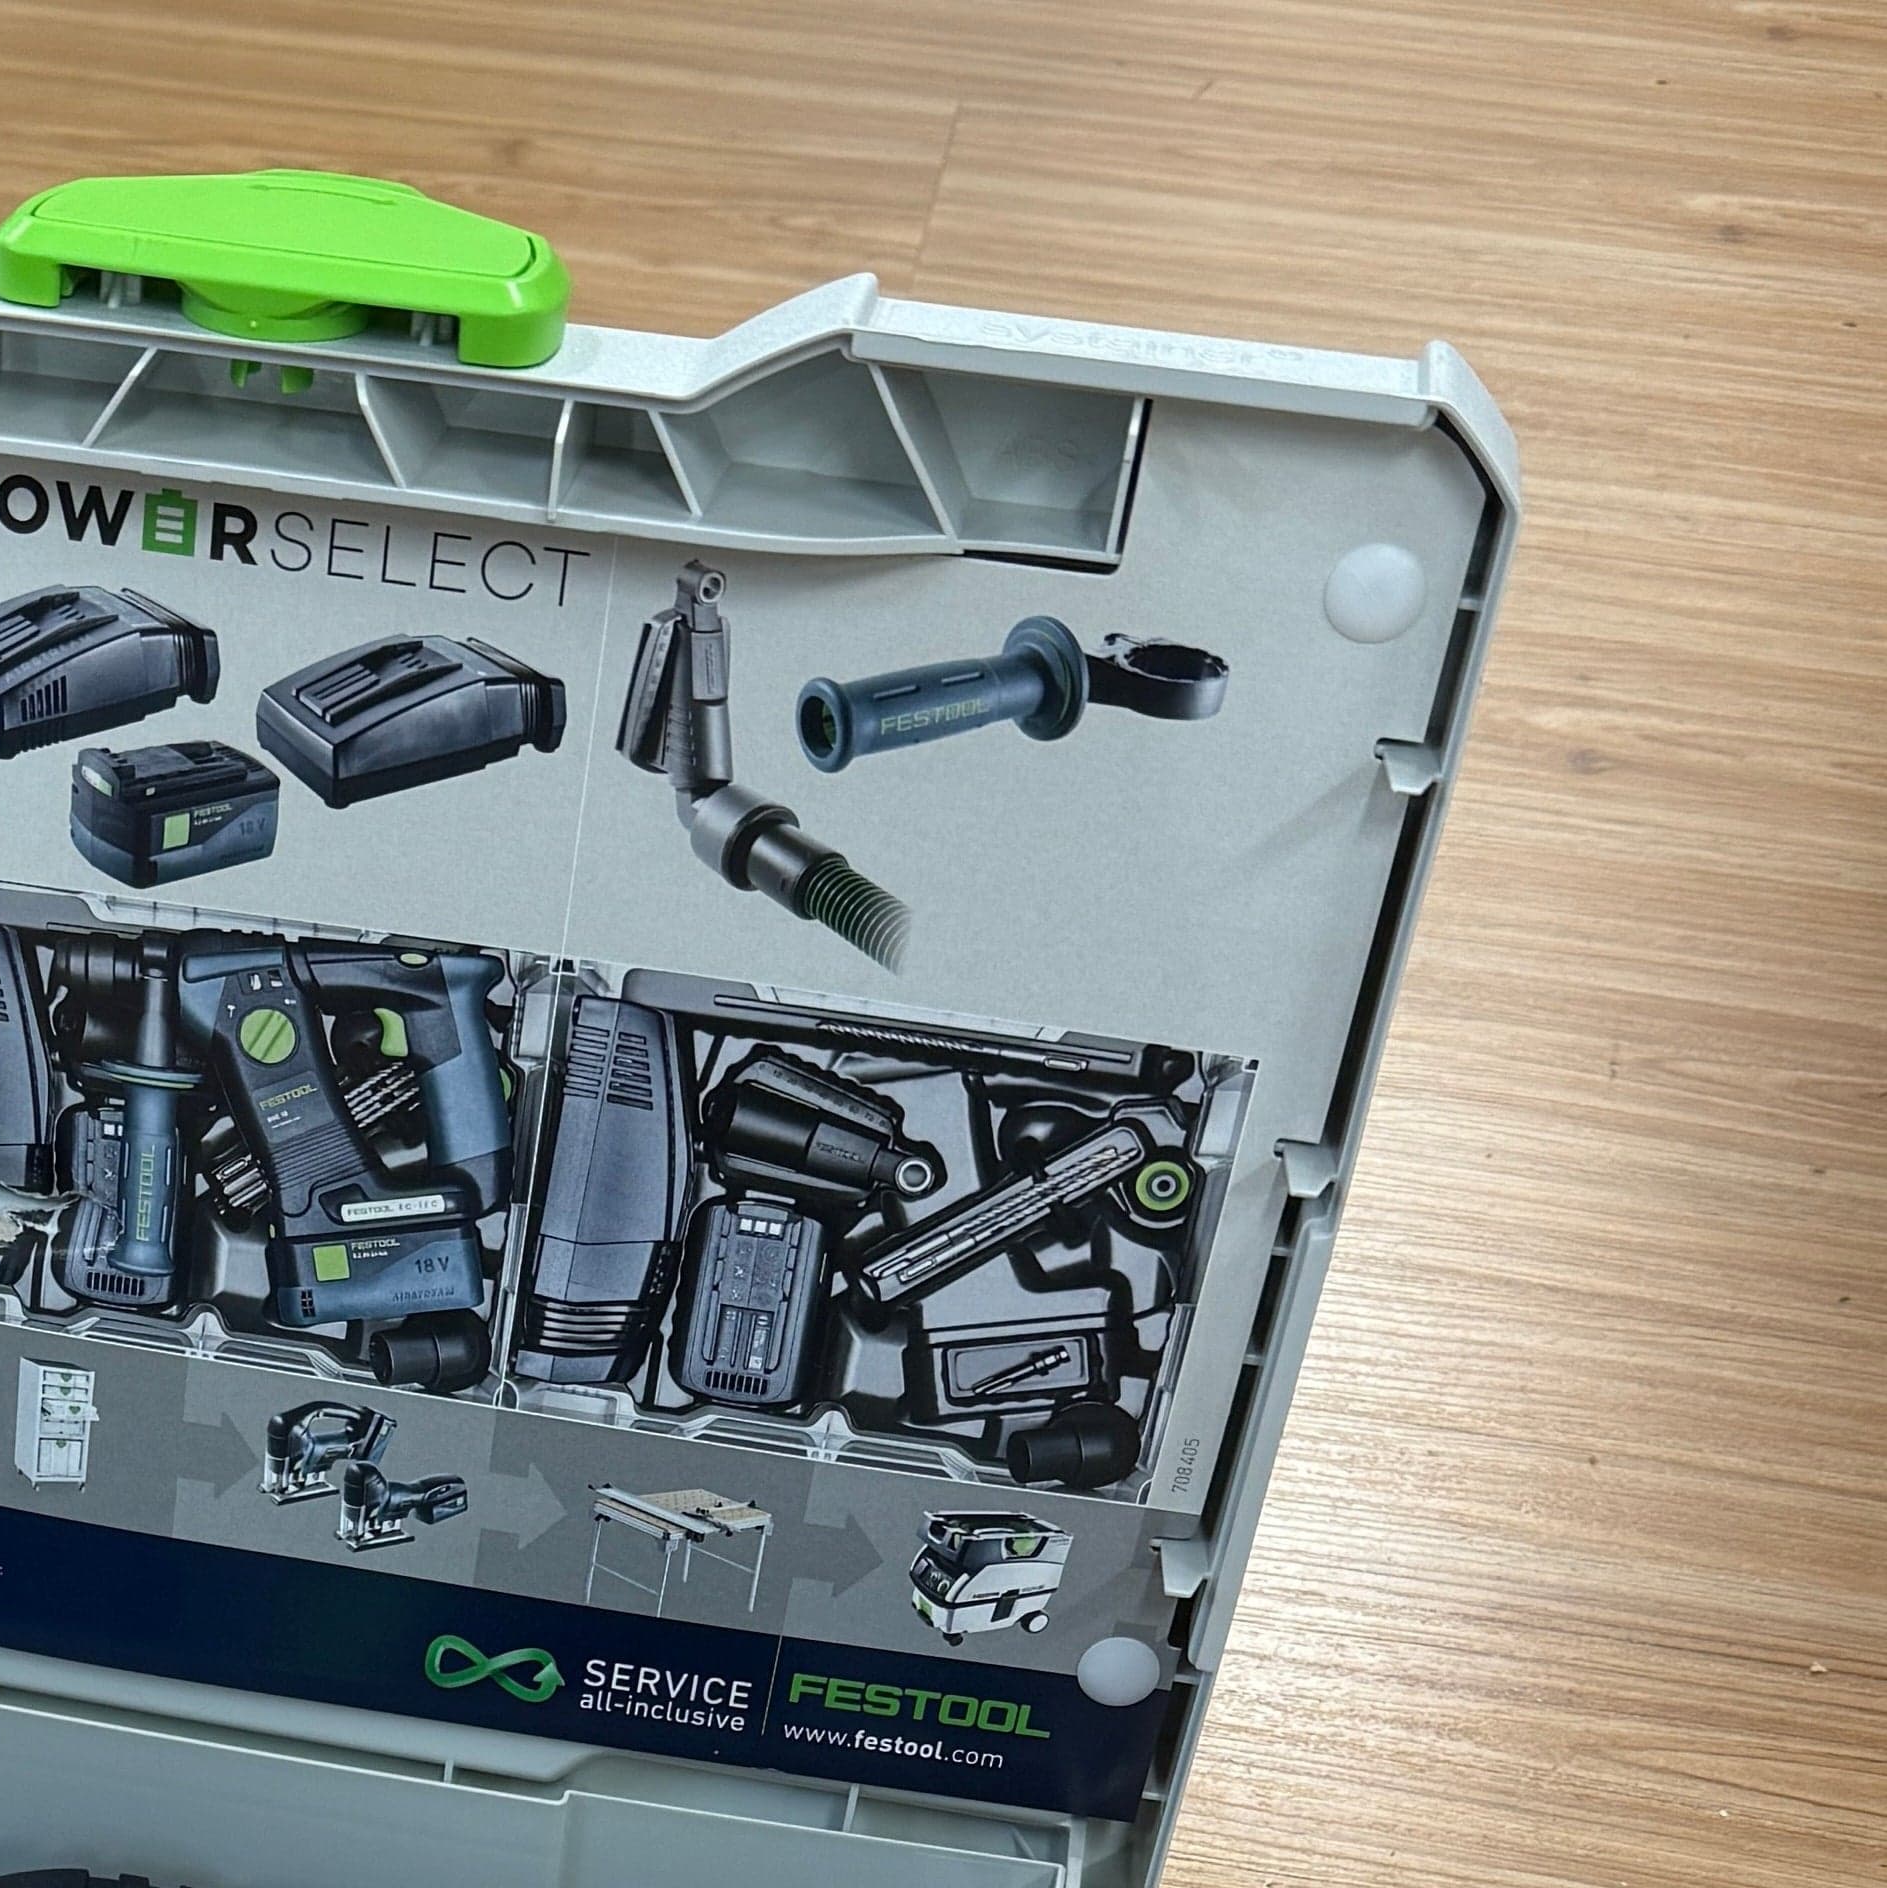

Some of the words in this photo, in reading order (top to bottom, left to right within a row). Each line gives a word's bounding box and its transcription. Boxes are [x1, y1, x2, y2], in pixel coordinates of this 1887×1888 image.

[880, 698, 990, 735] FESTOOL
[135, 1143, 155, 1241] FESTOOL
[414, 1257, 434, 1275] 18
[437, 1255, 450, 1273] V
[1171, 1438, 1201, 1493] 708405
[583, 1659, 753, 1710] SERVICE
[789, 1672, 1051, 1740] FESTOOL
[579, 1691, 747, 1732] all-inclusive
[783, 1722, 1004, 1770] www.festool.com
